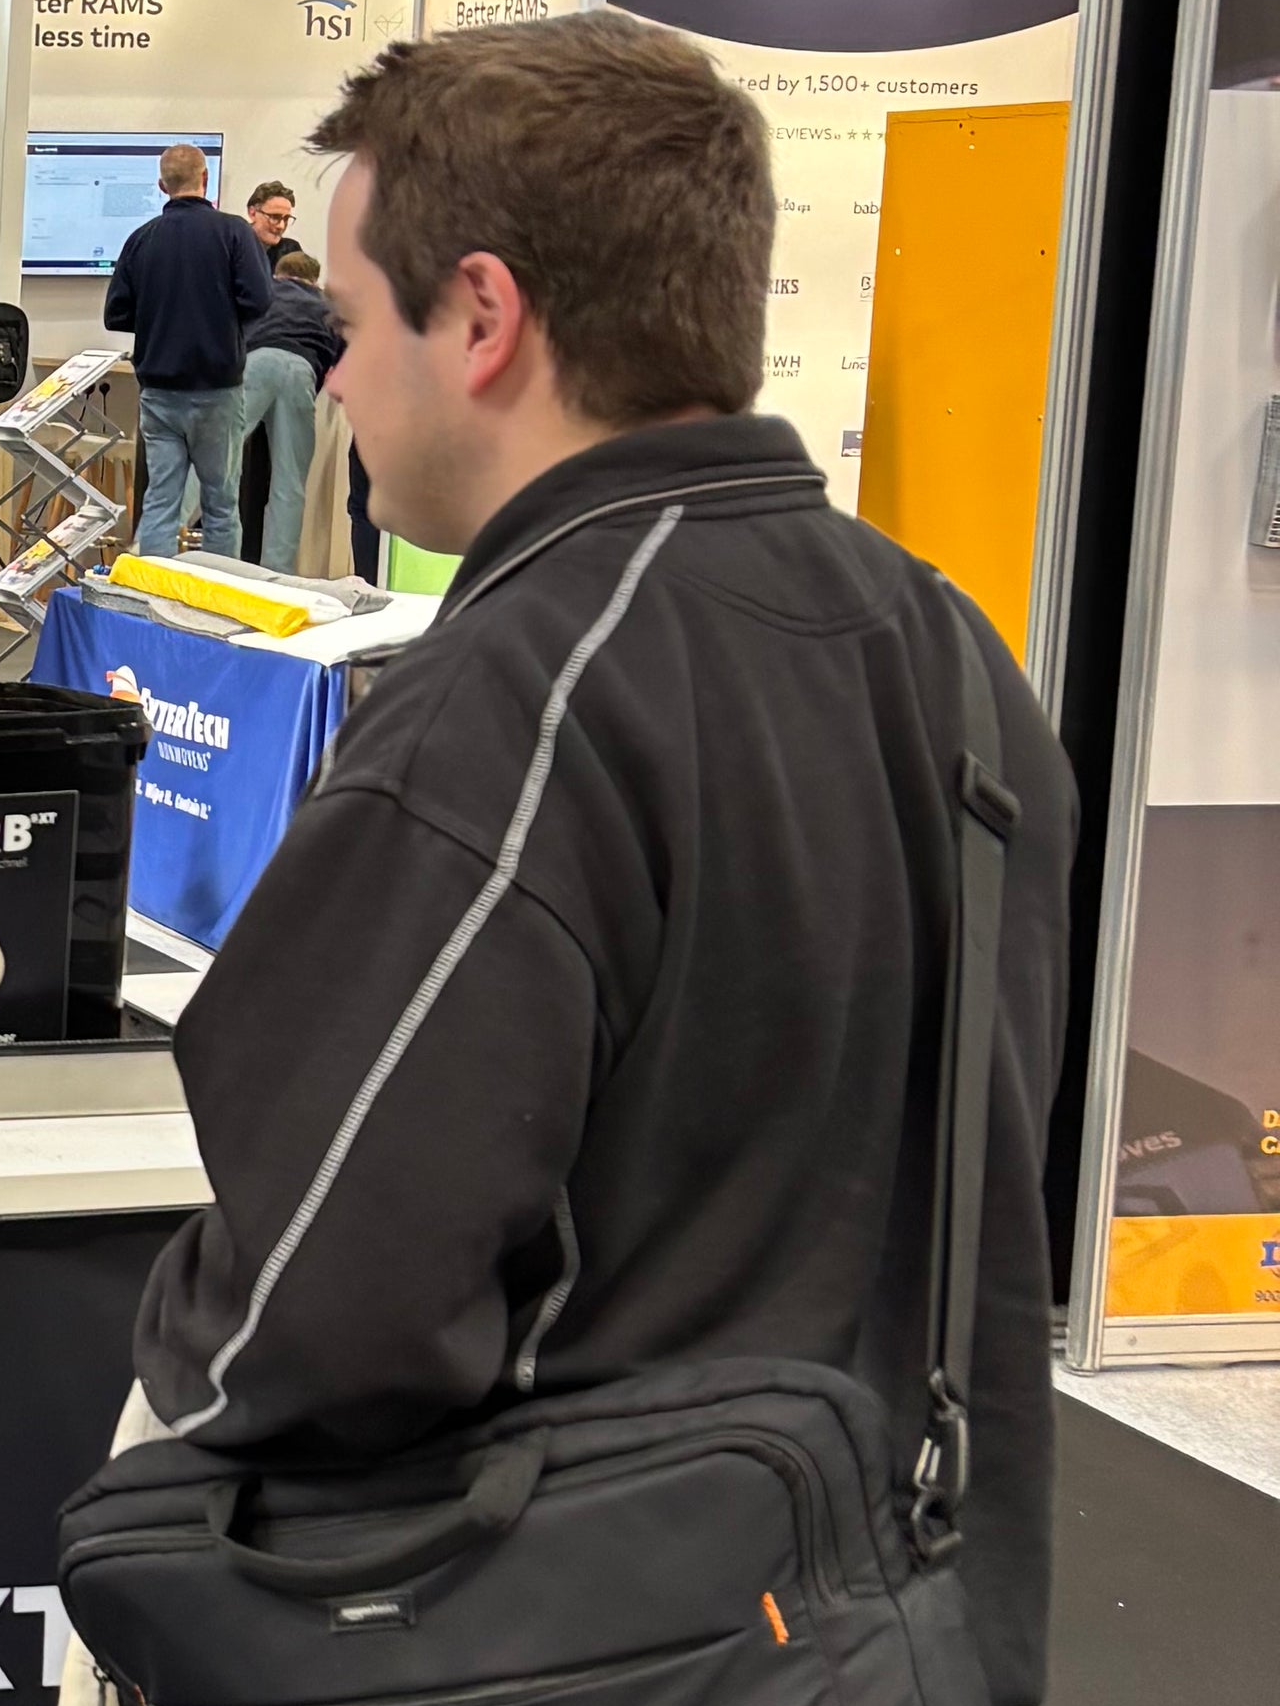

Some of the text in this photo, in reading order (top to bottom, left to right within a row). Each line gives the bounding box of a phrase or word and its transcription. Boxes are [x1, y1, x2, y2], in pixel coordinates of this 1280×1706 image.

[305, 2, 353, 41] hsi
[457, 1, 501, 27] Better
[34, 23, 151, 50] less time
[737, 74, 979, 96] ted by 1,500+ customers
